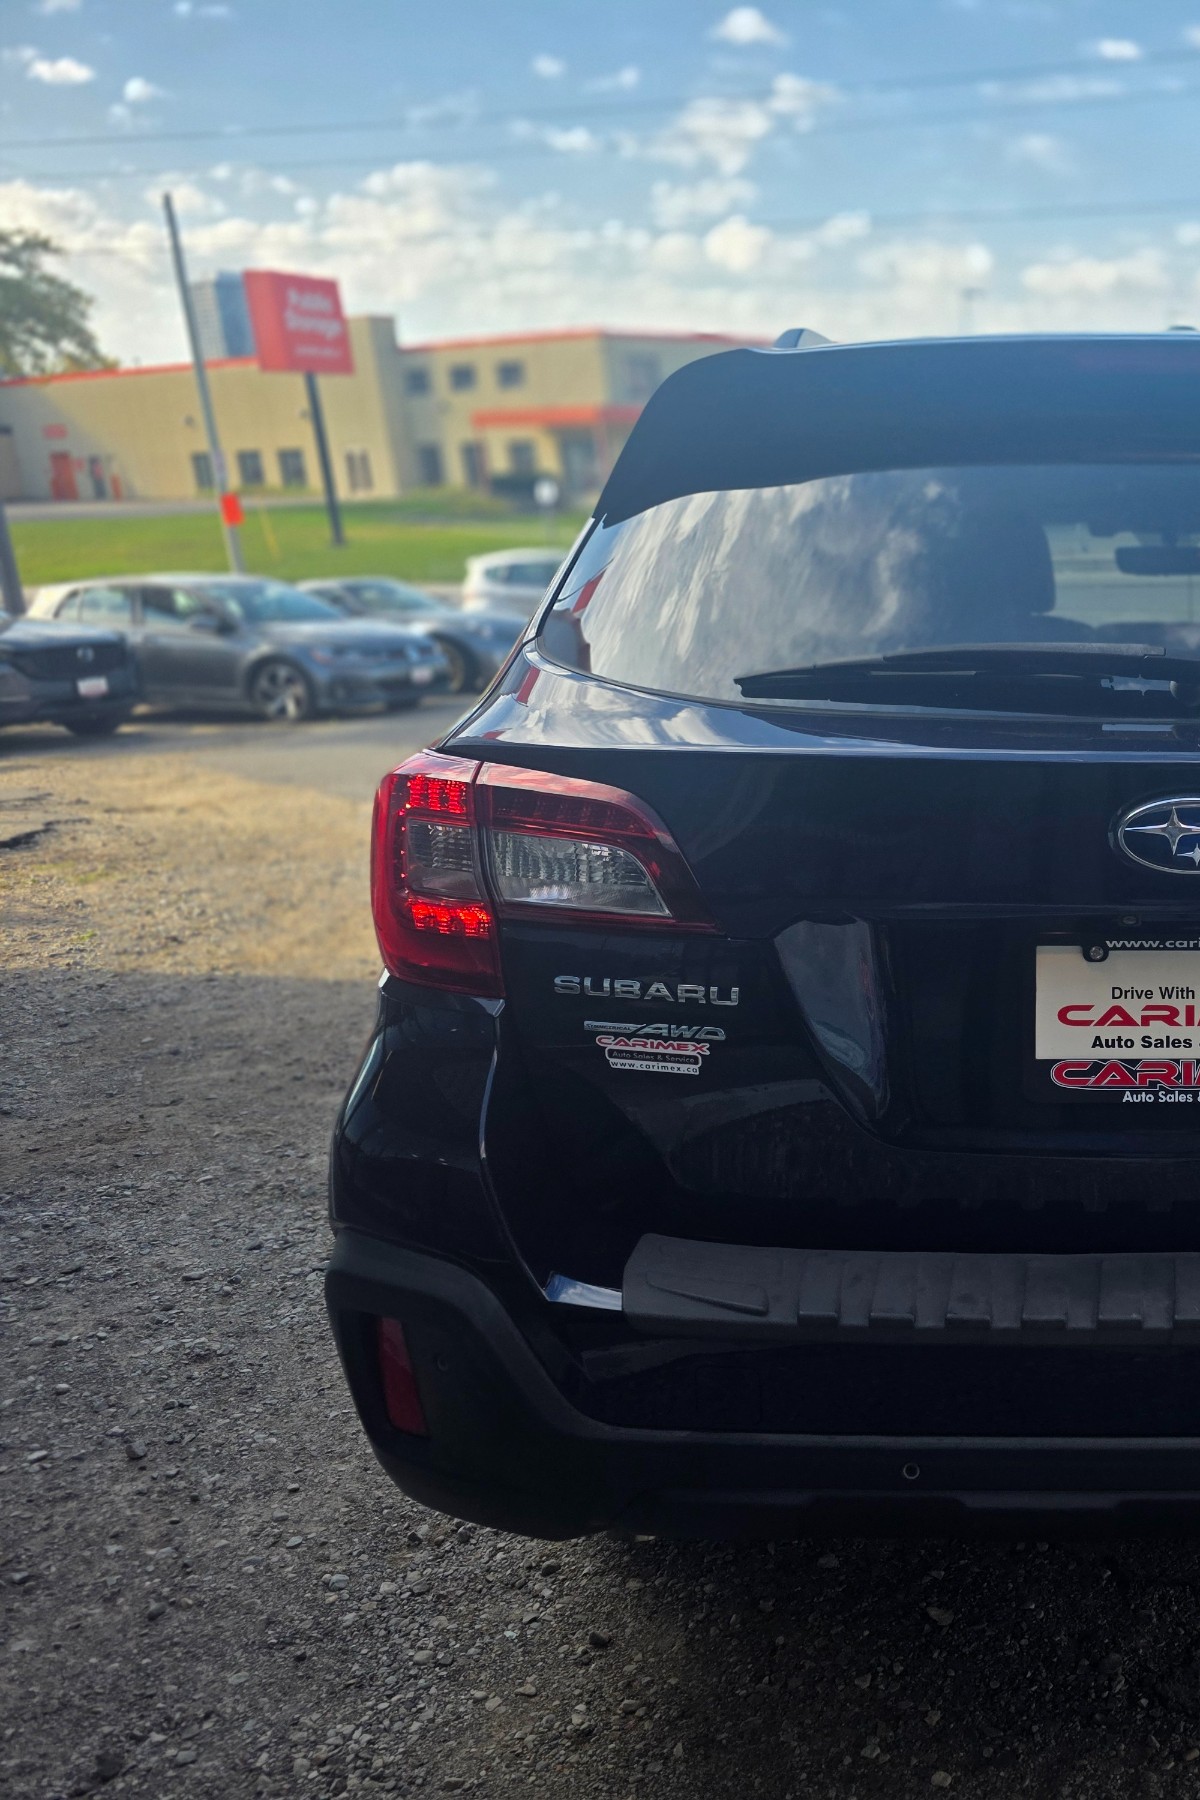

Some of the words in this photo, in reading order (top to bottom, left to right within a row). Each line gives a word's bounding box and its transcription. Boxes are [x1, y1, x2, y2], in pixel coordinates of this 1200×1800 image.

[553, 975, 740, 1006] SUBARU
[1111, 986, 1154, 1000] Drive
[1158, 986, 1196, 1000] With
[635, 1023, 726, 1041] AWD
[597, 1036, 710, 1054] CARIMEX
[1091, 1035, 1135, 1049] Auto
[1140, 1035, 1193, 1049] Sales
[612, 1050, 632, 1060] Auto
[633, 1052, 655, 1062] Sales
[656, 1053, 663, 1062] &
[665, 1055, 695, 1065] Service
[611, 1060, 698, 1074] www.carimex.ca
[1122, 1090, 1155, 1104] Auto
[1158, 1090, 1193, 1104] Sales
